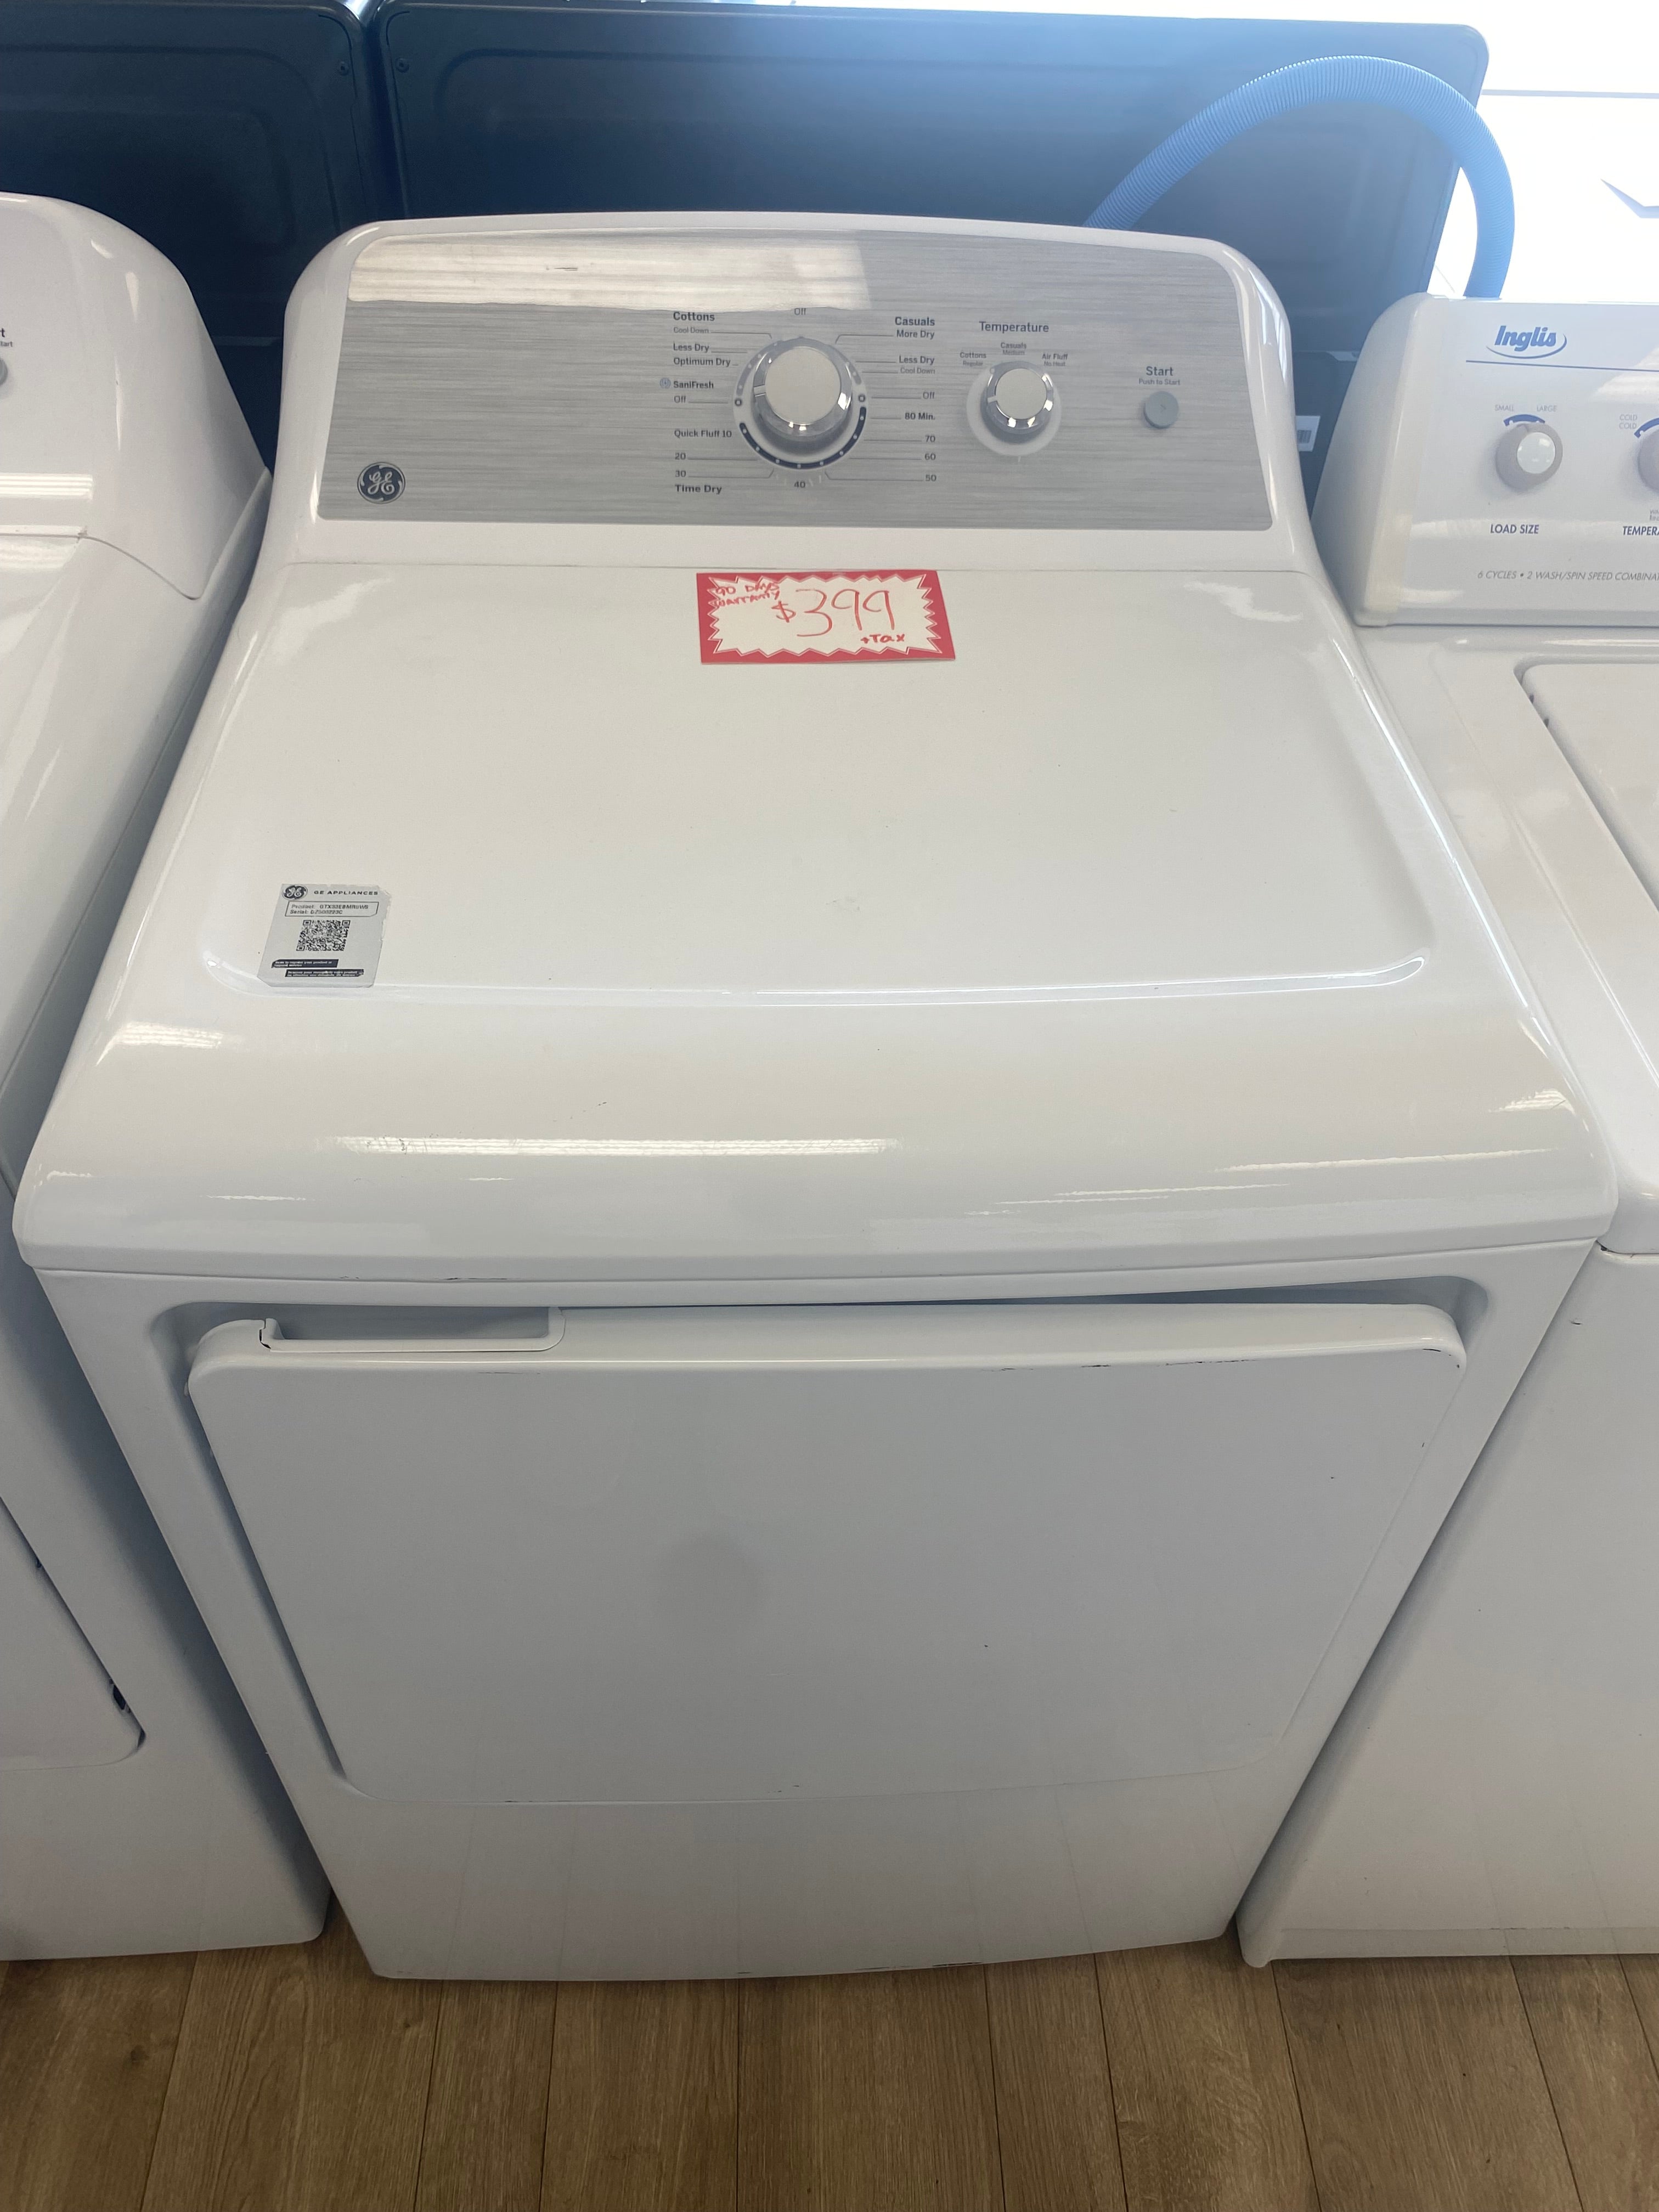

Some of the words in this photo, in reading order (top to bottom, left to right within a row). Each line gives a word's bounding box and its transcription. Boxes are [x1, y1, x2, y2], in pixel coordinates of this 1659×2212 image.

[673, 312, 715, 321] Cottons
[895, 317, 935, 326] Casuals
[979, 321, 1049, 334] Temperature
[896, 330, 918, 338] More
[920, 330, 934, 340] Dry
[1494, 325, 1556, 352] Inglis
[673, 343, 692, 351] Less
[695, 343, 709, 353] Dry
[673, 357, 713, 366] Optimum
[716, 358, 731, 367] Dry
[920, 356, 934, 365] Dry
[1146, 366, 1173, 376] Start
[675, 484, 701, 493] Time
[704, 485, 722, 494] Dry
[1491, 524, 1517, 534] LOAD
[1520, 524, 1539, 534] SIZE
[1486, 571, 1517, 579] CYCLES
[1527, 571, 1532, 579] 2
[1536, 571, 1586, 580] WASH/SPIN
[1588, 572, 1612, 580] SPEED
[715, 586, 736, 596] 90
[771, 589, 895, 637] $399
